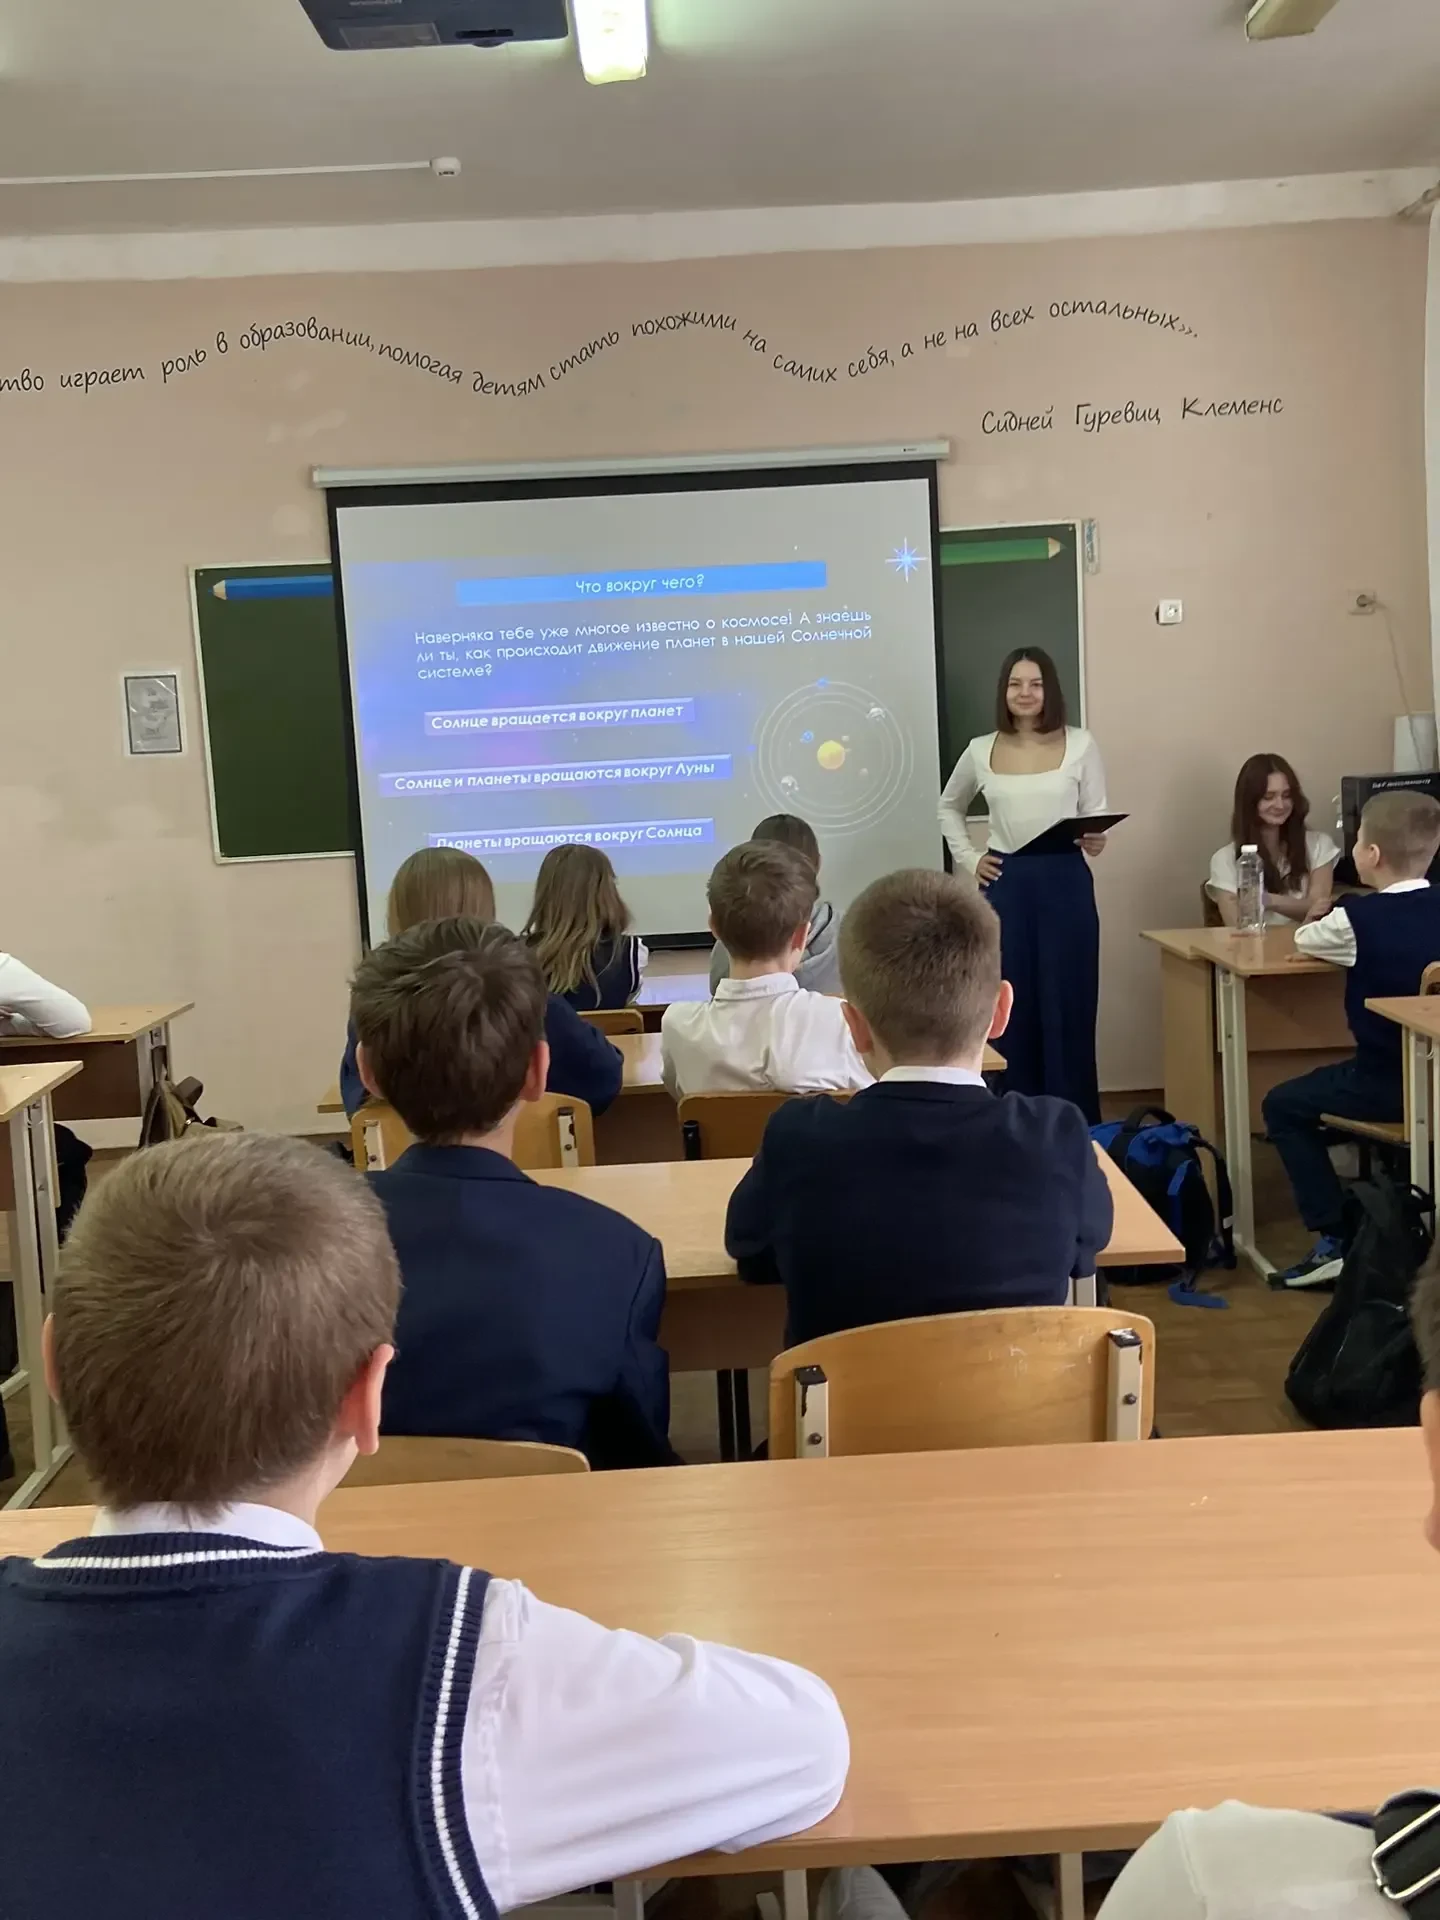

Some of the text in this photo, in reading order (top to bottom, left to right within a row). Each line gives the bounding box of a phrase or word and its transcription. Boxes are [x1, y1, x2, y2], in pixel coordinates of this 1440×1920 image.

[60, 366, 145, 393] играет
[161, 349, 207, 383] роль
[216, 332, 228, 354] в
[240, 316, 375, 352] образовании,
[378, 342, 463, 384] помогая
[472, 371, 546, 396] детям
[550, 331, 619, 381] стать
[632, 311, 737, 336] похожими
[742, 329, 767, 353] на
[773, 354, 837, 383] самих
[848, 346, 895, 378] себя,
[901, 342, 914, 358] а
[924, 331, 947, 349] не
[955, 322, 979, 340] на
[990, 305, 1034, 331] всех
[982, 405, 1055, 434] Сидней
[1182, 396, 1284, 420] Клеменс
[575, 573, 705, 595] Что вокруг чего?
[415, 630, 493, 646] Наверняка
[499, 626, 534, 640] тебе
[540, 626, 569, 640] уже
[575, 623, 630, 637] многое
[636, 619, 700, 632] известно
[705, 618, 716, 630] о
[722, 611, 793, 629] космосе!
[799, 611, 811, 624] А
[416, 625, 872, 663] ли ты, как происходит движение планет в нашей Солнечной
[417, 663, 493, 680] системе?
[431, 704, 684, 730] Солнце вращается вокруг планет
[394, 761, 715, 791] Солнце и планеты вращаются вокруг Луны
[504, 831, 592, 849] вращаются
[595, 828, 643, 845] вокруг
[646, 825, 702, 840] Солнца
